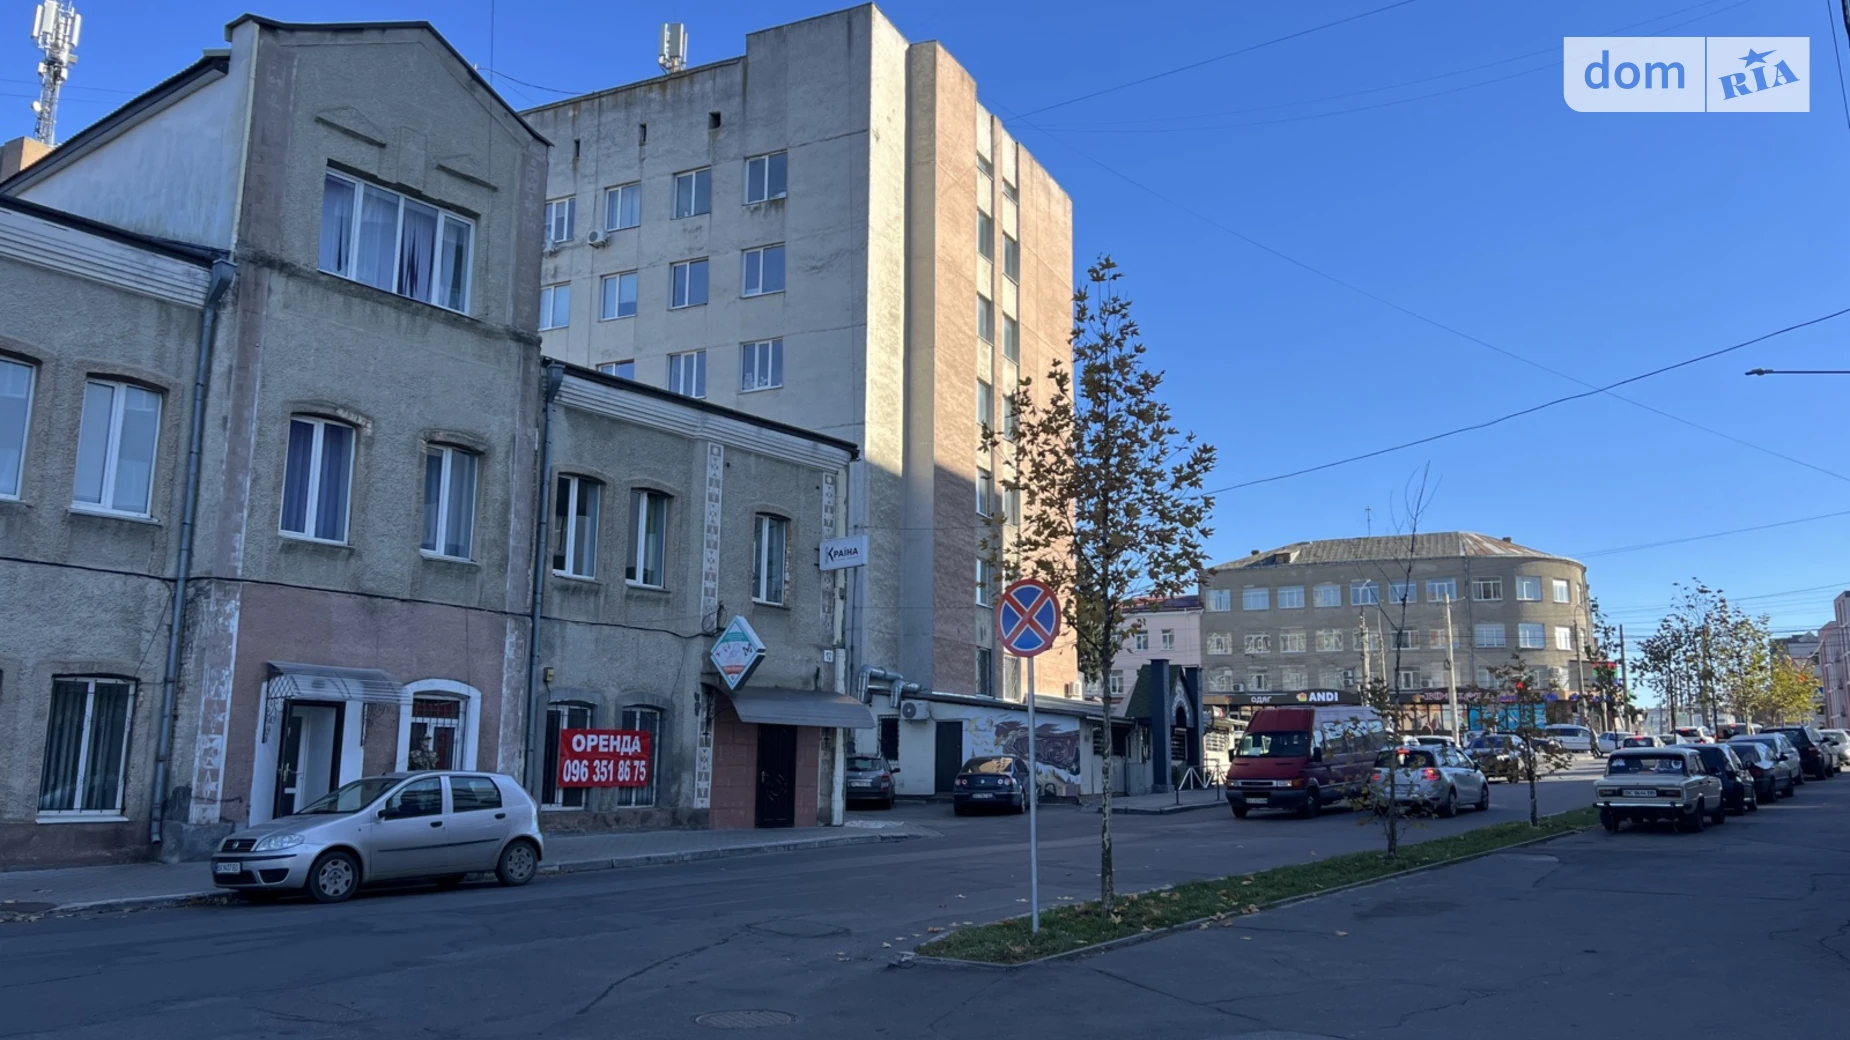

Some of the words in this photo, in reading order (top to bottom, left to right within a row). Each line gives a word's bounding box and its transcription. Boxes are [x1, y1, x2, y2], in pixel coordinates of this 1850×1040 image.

[1250, 695, 1272, 704] ОДЯГ
[1308, 691, 1339, 702] ANDI
[572, 734, 641, 756] ОРЕНДА
[563, 759, 589, 782] 096
[592, 759, 614, 782] 351
[617, 760, 630, 782] 86
[633, 760, 646, 782] 75
